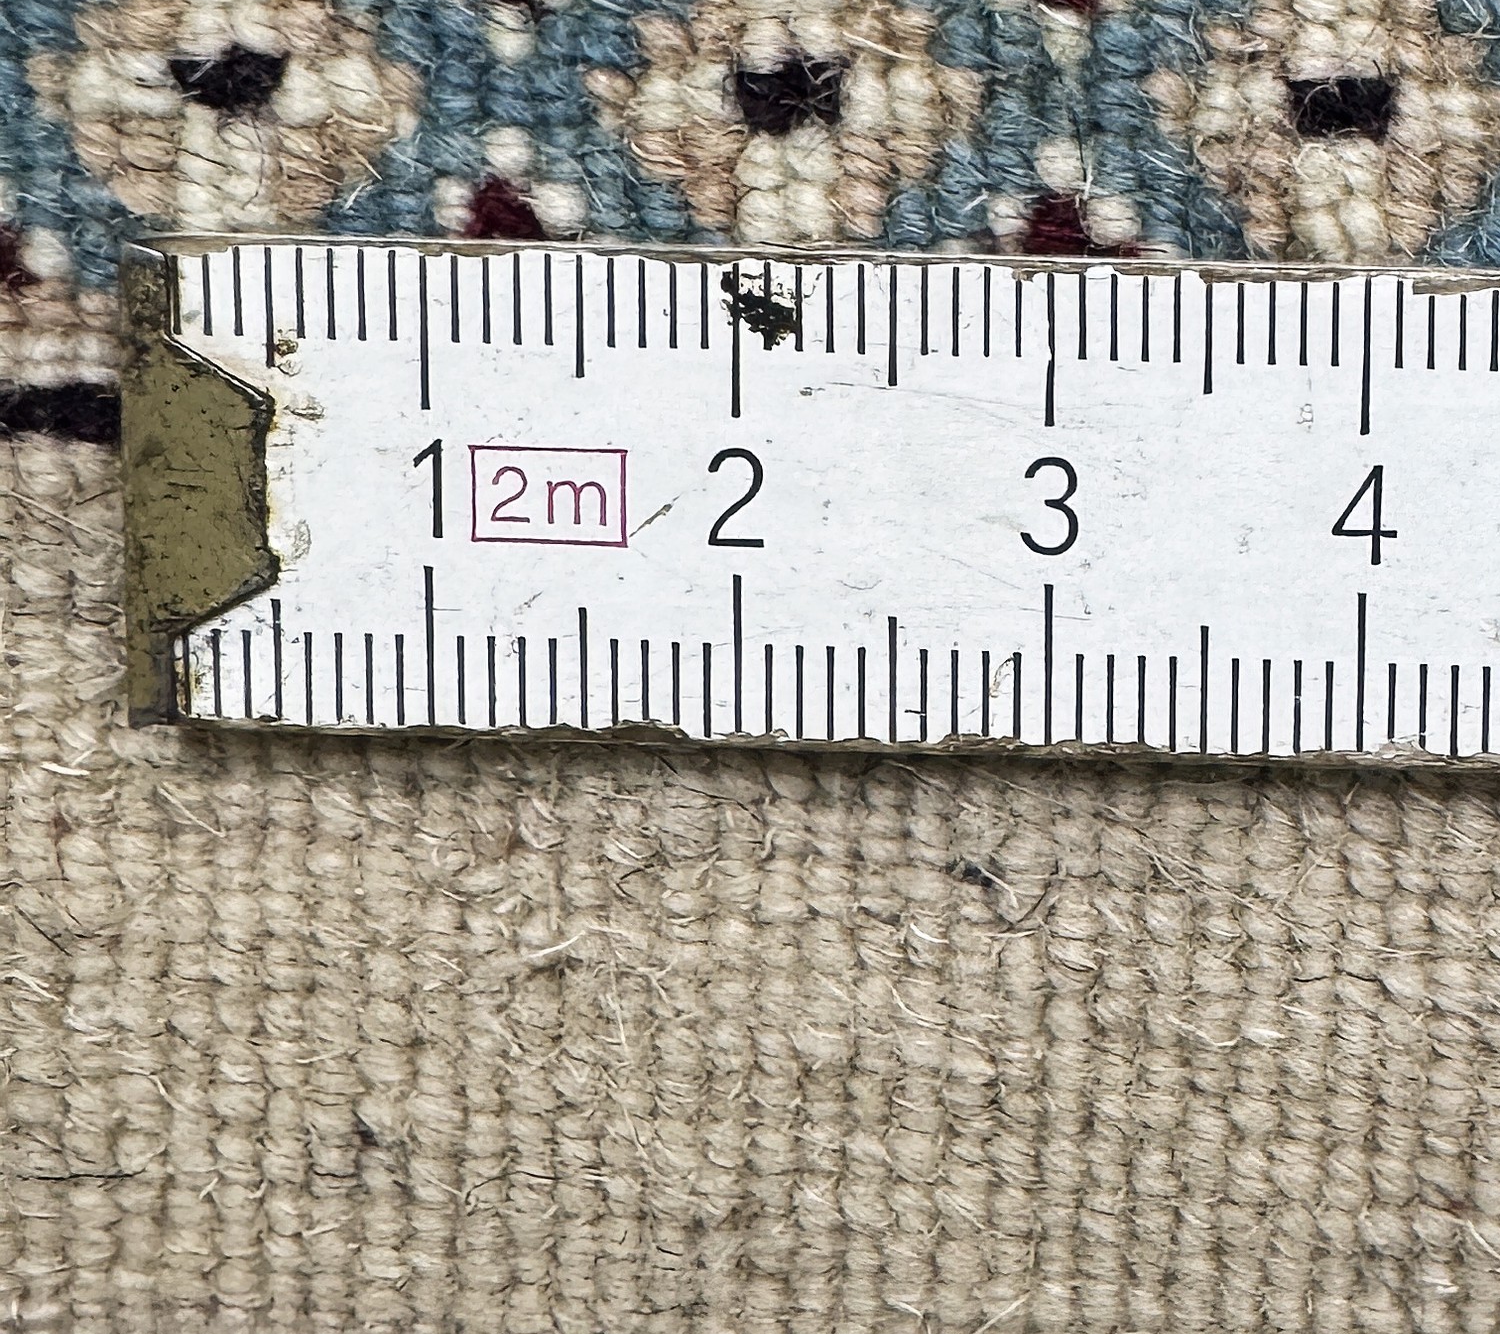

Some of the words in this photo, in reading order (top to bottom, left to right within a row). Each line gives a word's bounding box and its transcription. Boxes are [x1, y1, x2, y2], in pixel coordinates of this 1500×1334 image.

[412, 438, 444, 539] 1
[707, 447, 765, 549] 2
[1019, 456, 1079, 556] 3
[1331, 464, 1398, 566] 4
[489, 464, 609, 527] 2m
